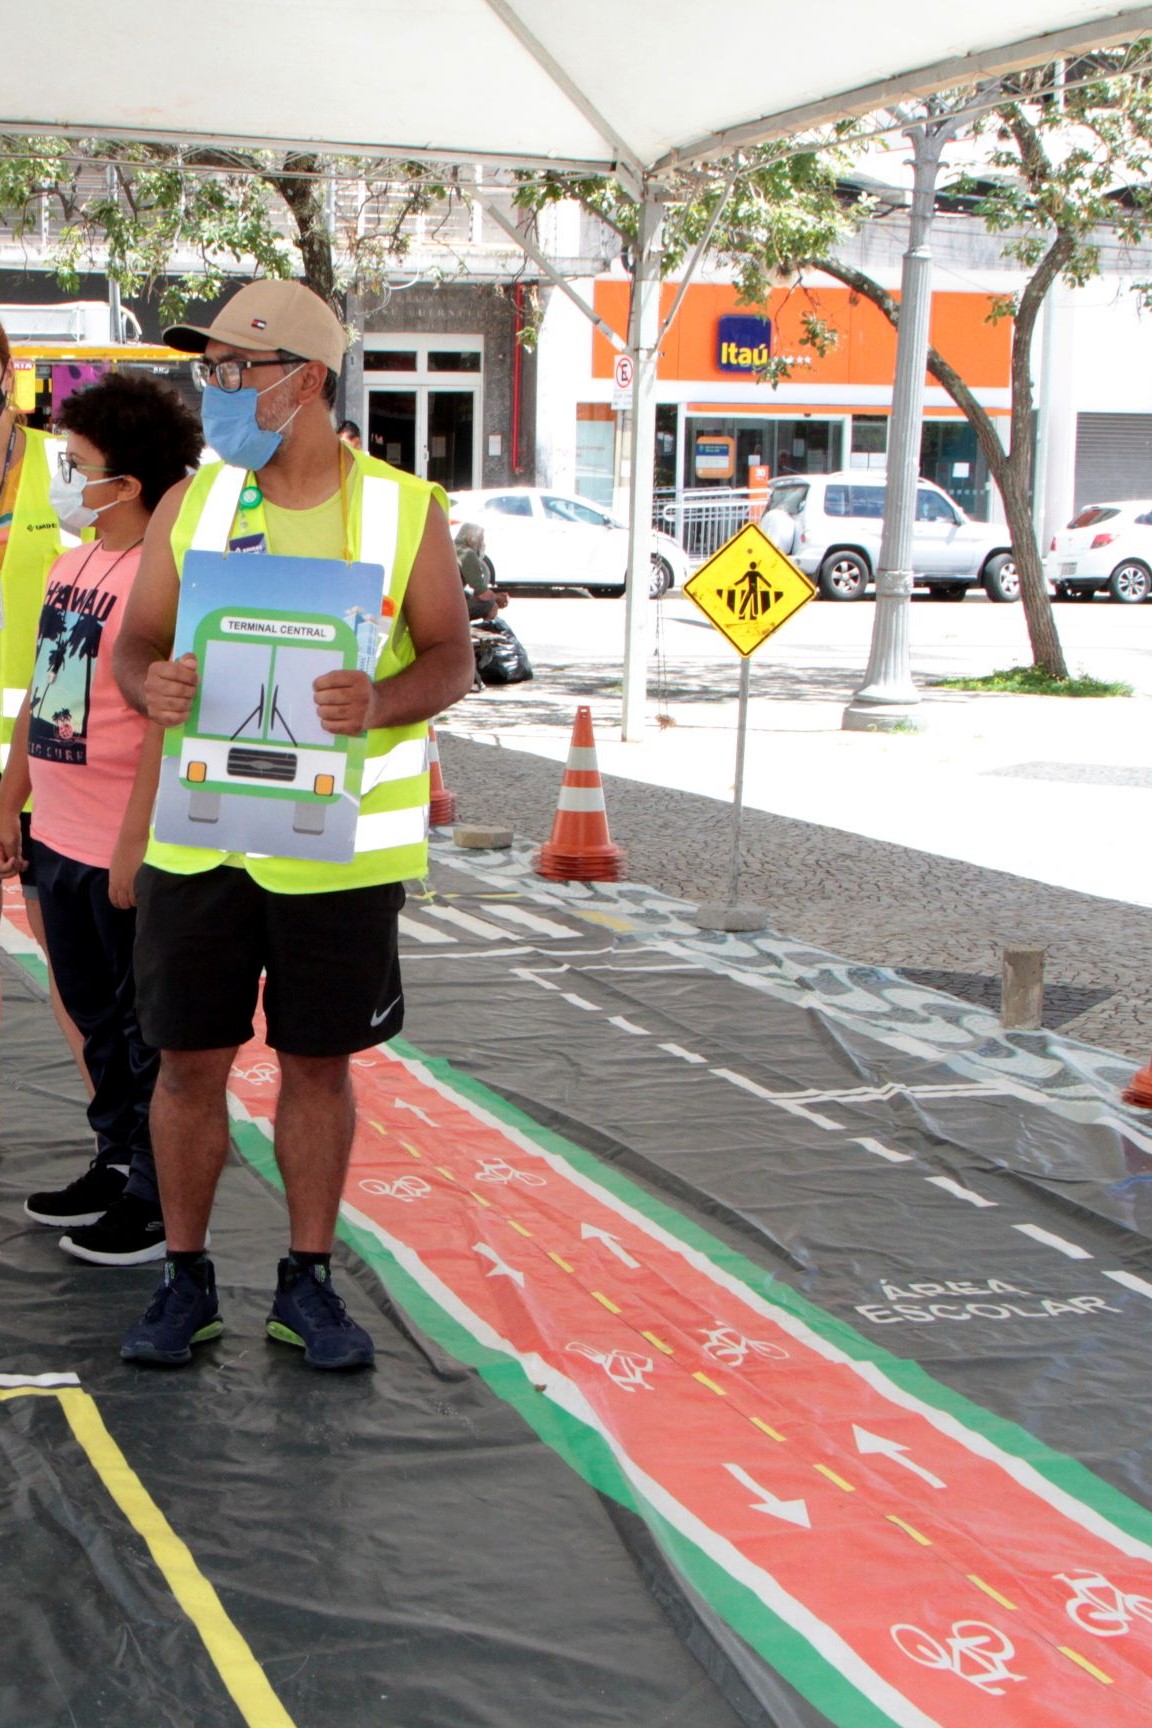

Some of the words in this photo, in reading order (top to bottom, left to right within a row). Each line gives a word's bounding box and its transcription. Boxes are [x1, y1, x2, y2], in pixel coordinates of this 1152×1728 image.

[721, 341, 768, 366] Itaú
[44, 580, 118, 622] HAWAII
[228, 620, 278, 634] TERMINAL
[280, 625, 327, 638] CENTRAL
[880, 1277, 1031, 1301] ÁREA
[855, 1296, 1123, 1324] ESCOLAR
